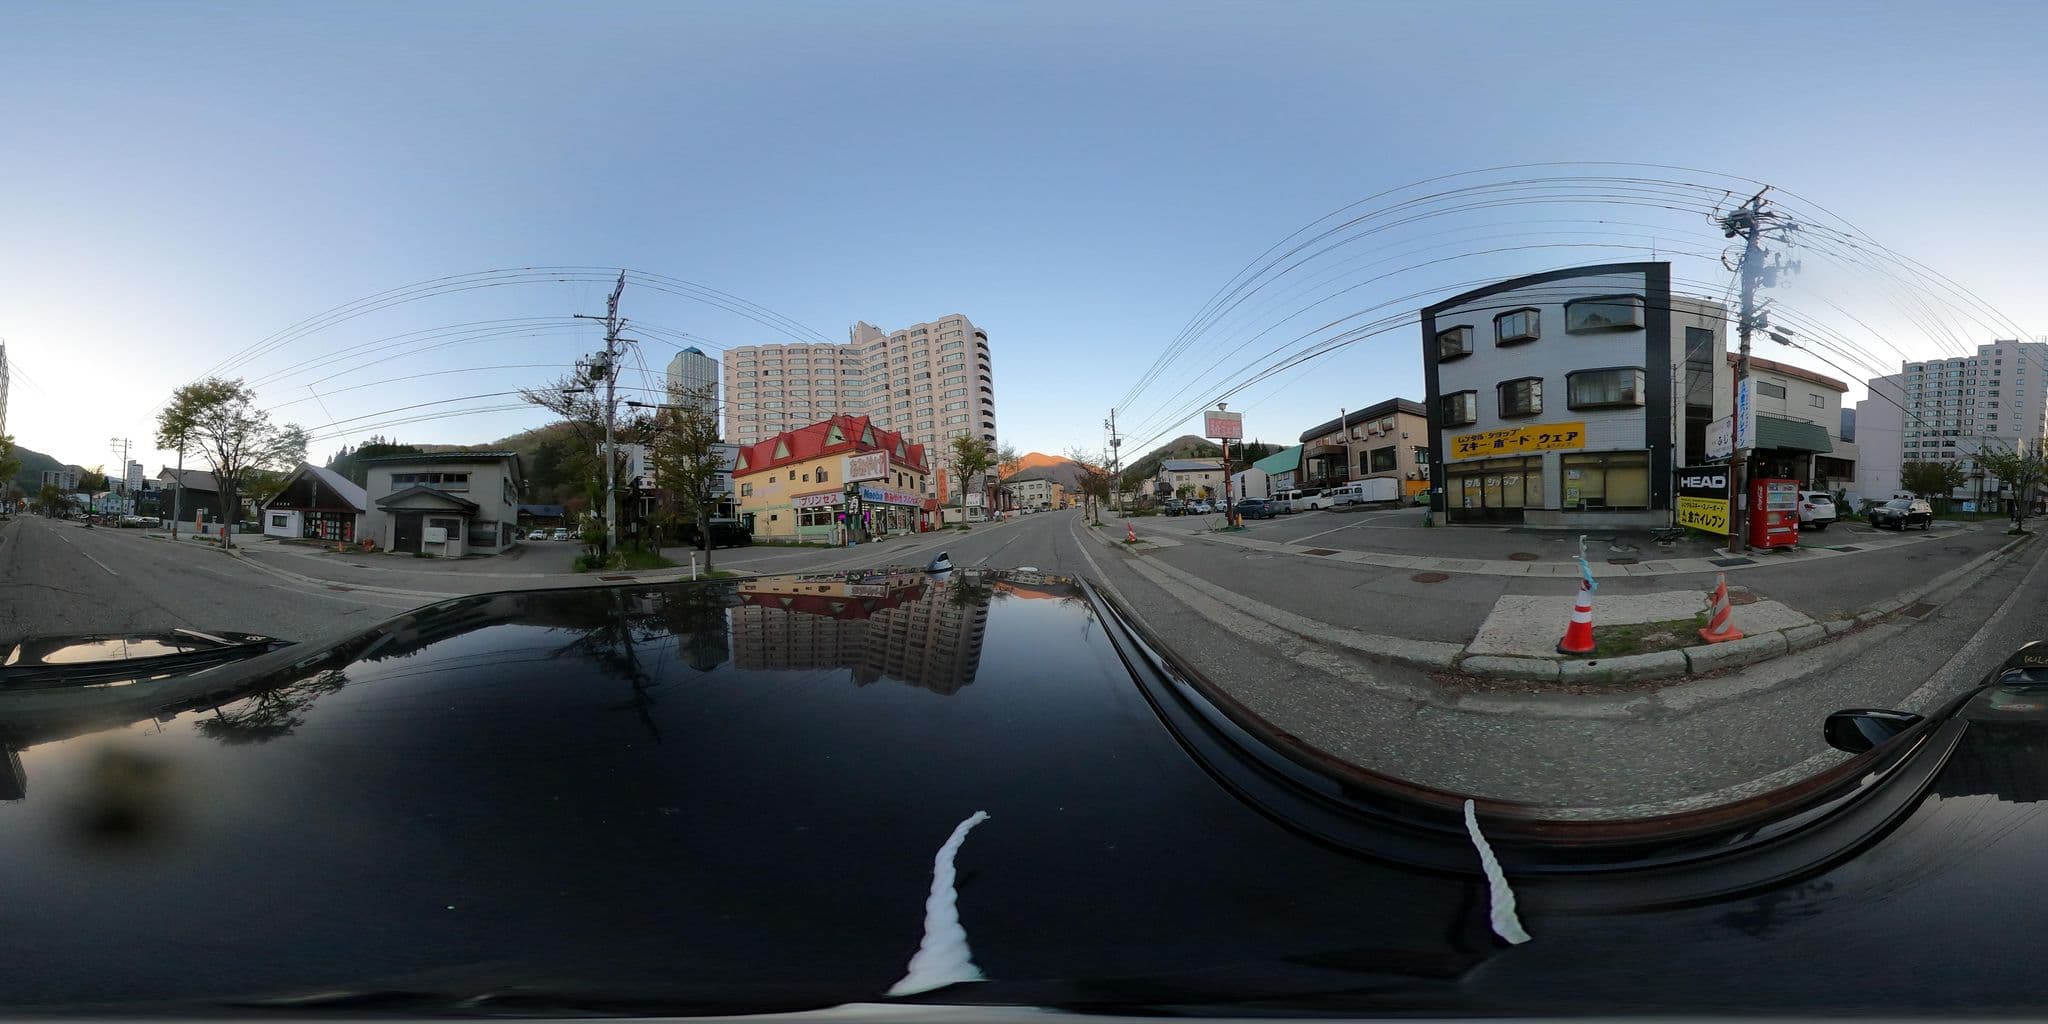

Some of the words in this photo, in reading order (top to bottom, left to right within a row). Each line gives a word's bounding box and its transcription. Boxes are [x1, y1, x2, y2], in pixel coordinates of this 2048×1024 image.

[1681, 475, 1726, 488] HEAD
[800, 493, 838, 507] プリンセス
